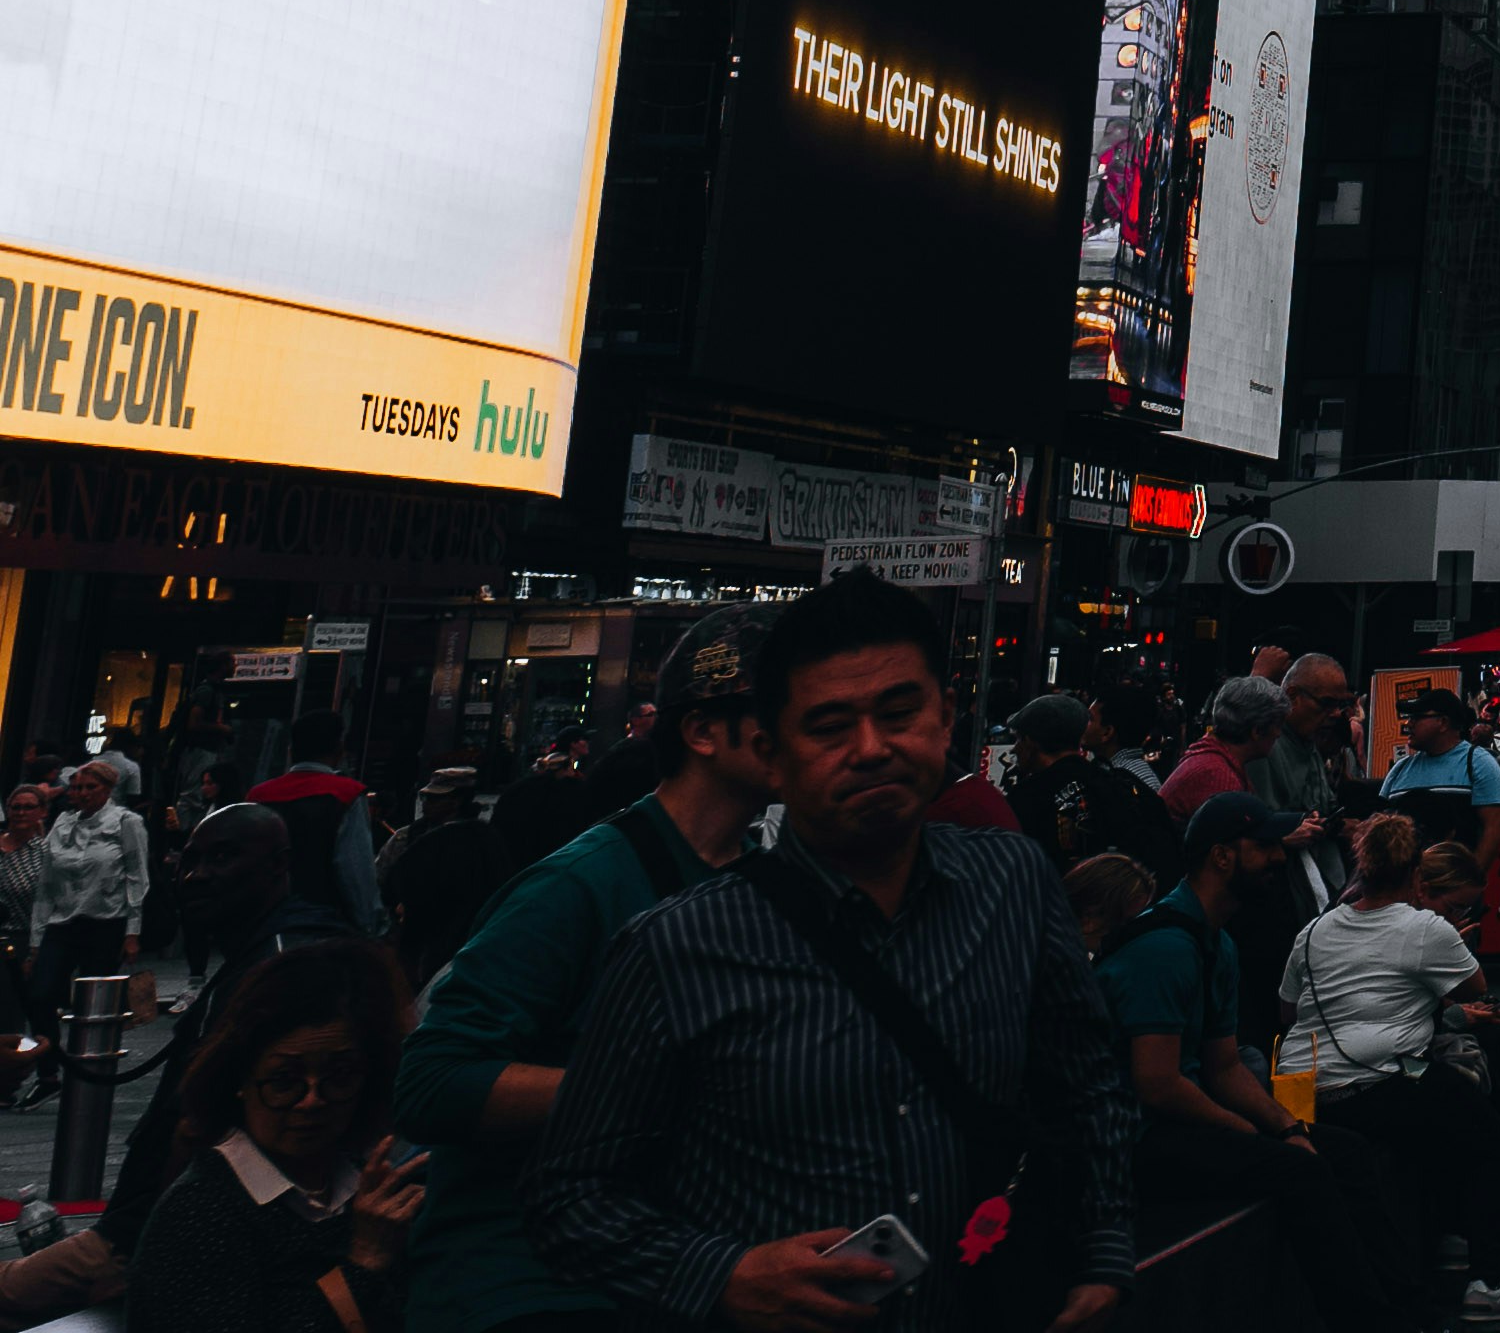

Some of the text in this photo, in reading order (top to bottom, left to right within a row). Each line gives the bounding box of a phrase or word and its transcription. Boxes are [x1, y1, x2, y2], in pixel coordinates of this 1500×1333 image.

[794, 28, 1061, 193] THEIR LIGHT STILL SHINES
[77, 294, 198, 429] ICON.
[360, 393, 460, 442] TUESDAYS
[474, 380, 548, 460] hulu
[667, 442, 699, 470] SPORTS
[1072, 462, 1104, 500] BLUE
[831, 542, 969, 561] PEDESTRIAN FLOW ZONE
[891, 562, 968, 579] KEEP MOVING
